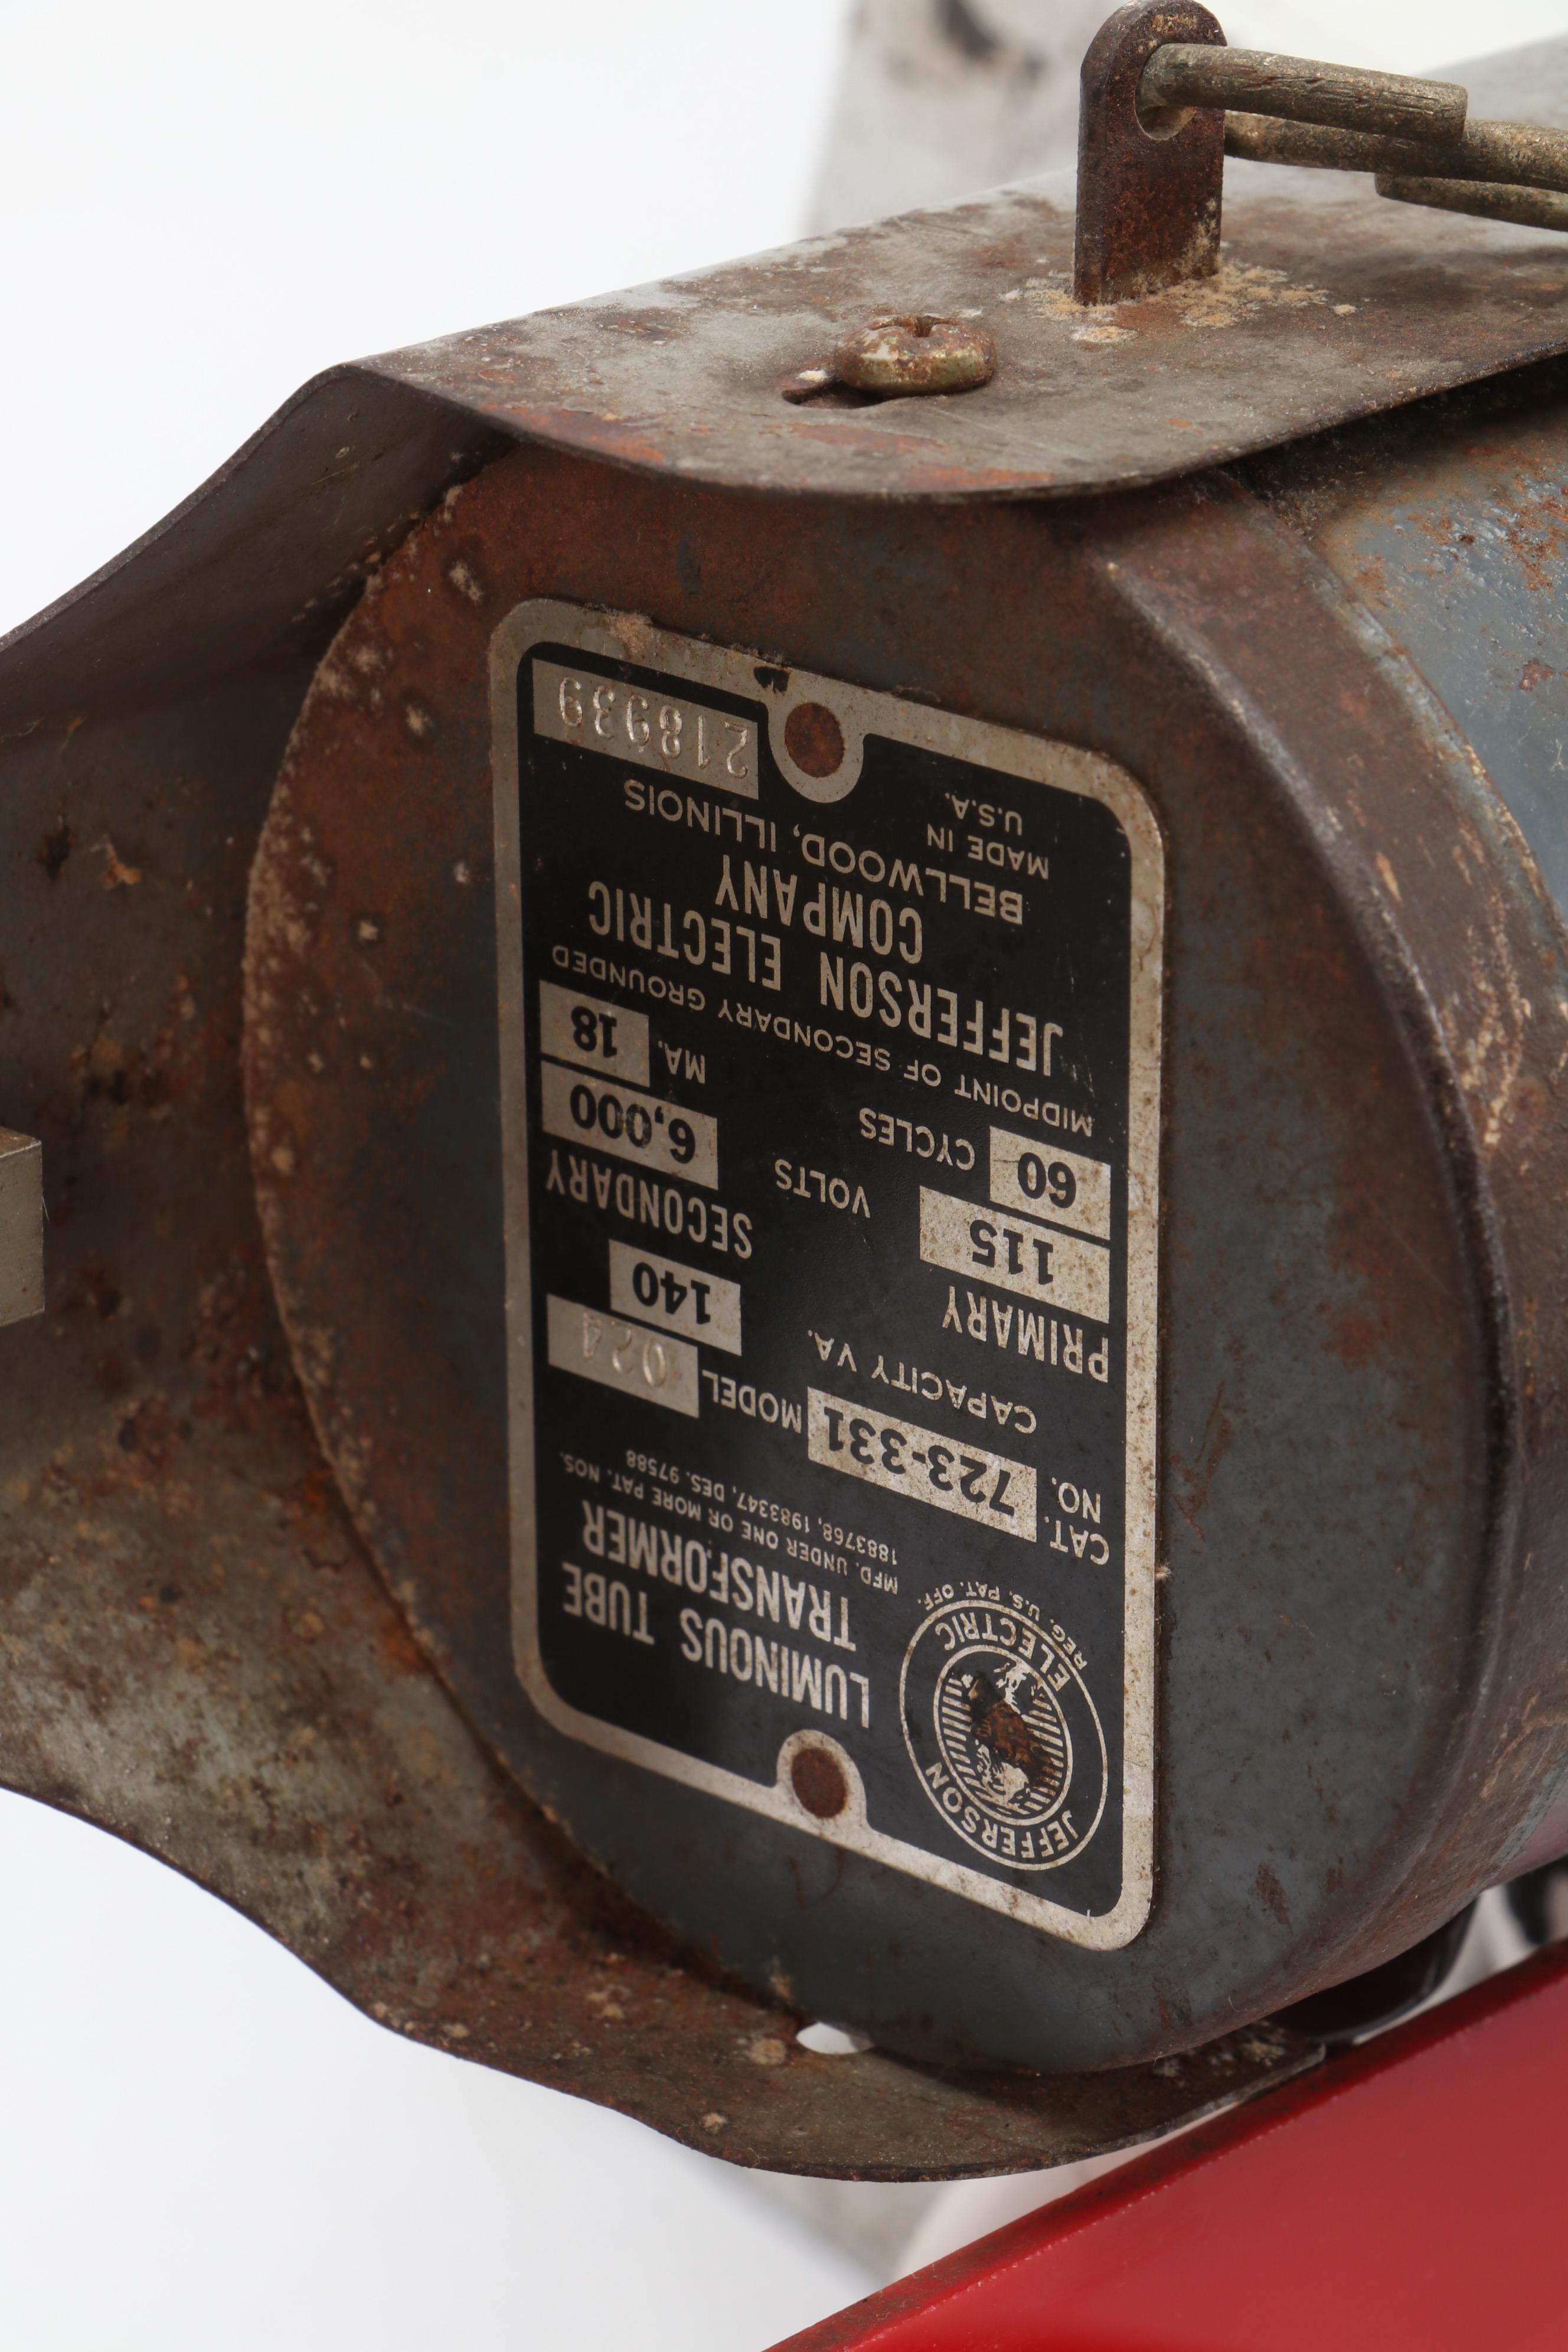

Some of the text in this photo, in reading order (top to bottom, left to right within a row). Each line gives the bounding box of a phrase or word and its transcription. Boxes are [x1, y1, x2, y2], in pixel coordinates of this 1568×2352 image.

[559, 677, 748, 779] 218939
[623, 779, 1023, 925] BELLWOOD, ILLINOIS
[926, 822, 1048, 880] MADE IN
[944, 793, 1023, 835] U.S.A.
[715, 854, 922, 963] COMPANY
[588, 880, 1063, 1076] JEFFERSON ELECTRIC
[552, 945, 1092, 1137] MIDPOINT OF SECONDARY GROUNDED
[571, 1007, 705, 1084] MA. 18
[546, 1149, 752, 1259] SECONDARY
[570, 1084, 1053, 1285] 115 VOLTS 6,000
[858, 1108, 1076, 1208] 60 CYCLES
[632, 1262, 1037, 1433] CAPACITY VA. 140
[942, 1286, 1109, 1383] PRIMARY
[701, 1370, 801, 1433] MODEL
[626, 1450, 897, 1565] 1883768, 1983347, DES. 97588
[823, 1407, 1015, 1517] 723-331
[1051, 1477, 1101, 1523] NO.
[559, 1451, 897, 1595] MFD. UNDER ONE OR MORE PAT. NOS.
[1044, 1516, 1109, 1565] CAT.
[582, 1501, 856, 1651] TRANSFORMER
[917, 1582, 1087, 1670] REG. U.S. PAT. OFF.
[562, 1562, 870, 1729] LUMINOUS TUBE
[935, 1612, 1071, 1691] ELECTRIC
[925, 1762, 1080, 1858] JEFFERSON
